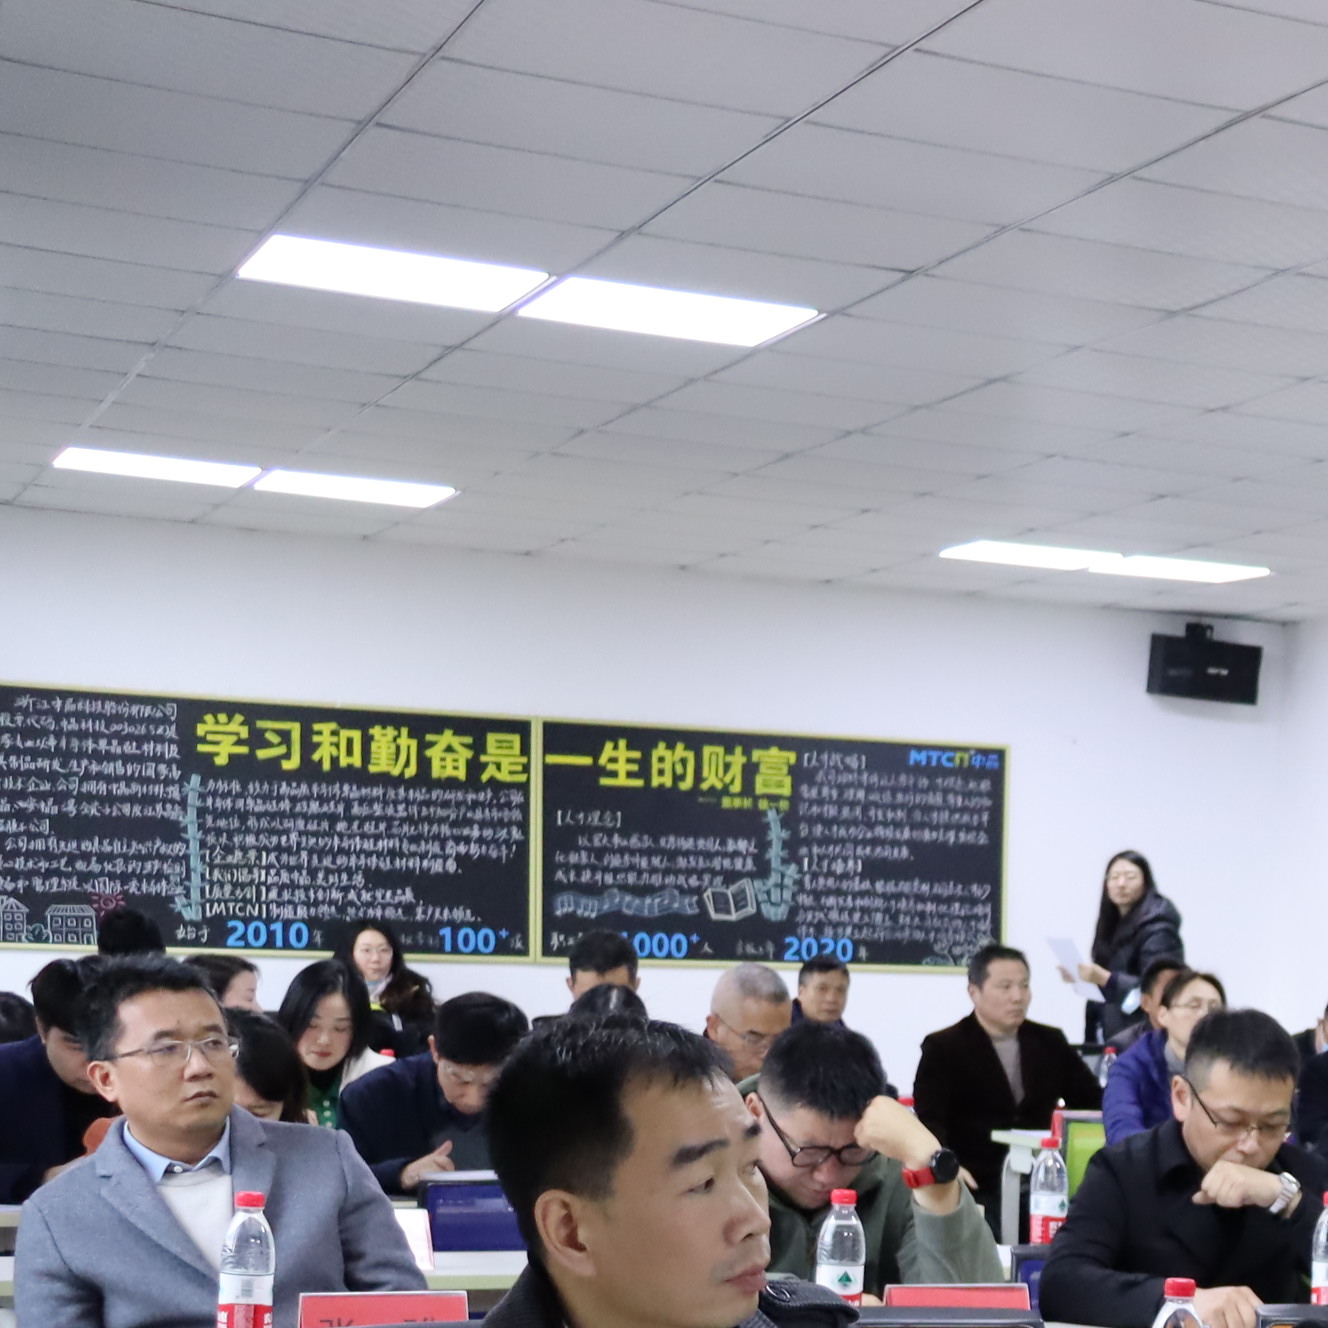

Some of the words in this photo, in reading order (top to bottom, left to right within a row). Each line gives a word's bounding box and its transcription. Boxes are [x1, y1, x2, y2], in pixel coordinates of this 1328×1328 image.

[196, 712, 529, 783] 学习和勤奋是
[545, 738, 797, 796] 一生的财富
[226, 920, 309, 949] 2010
